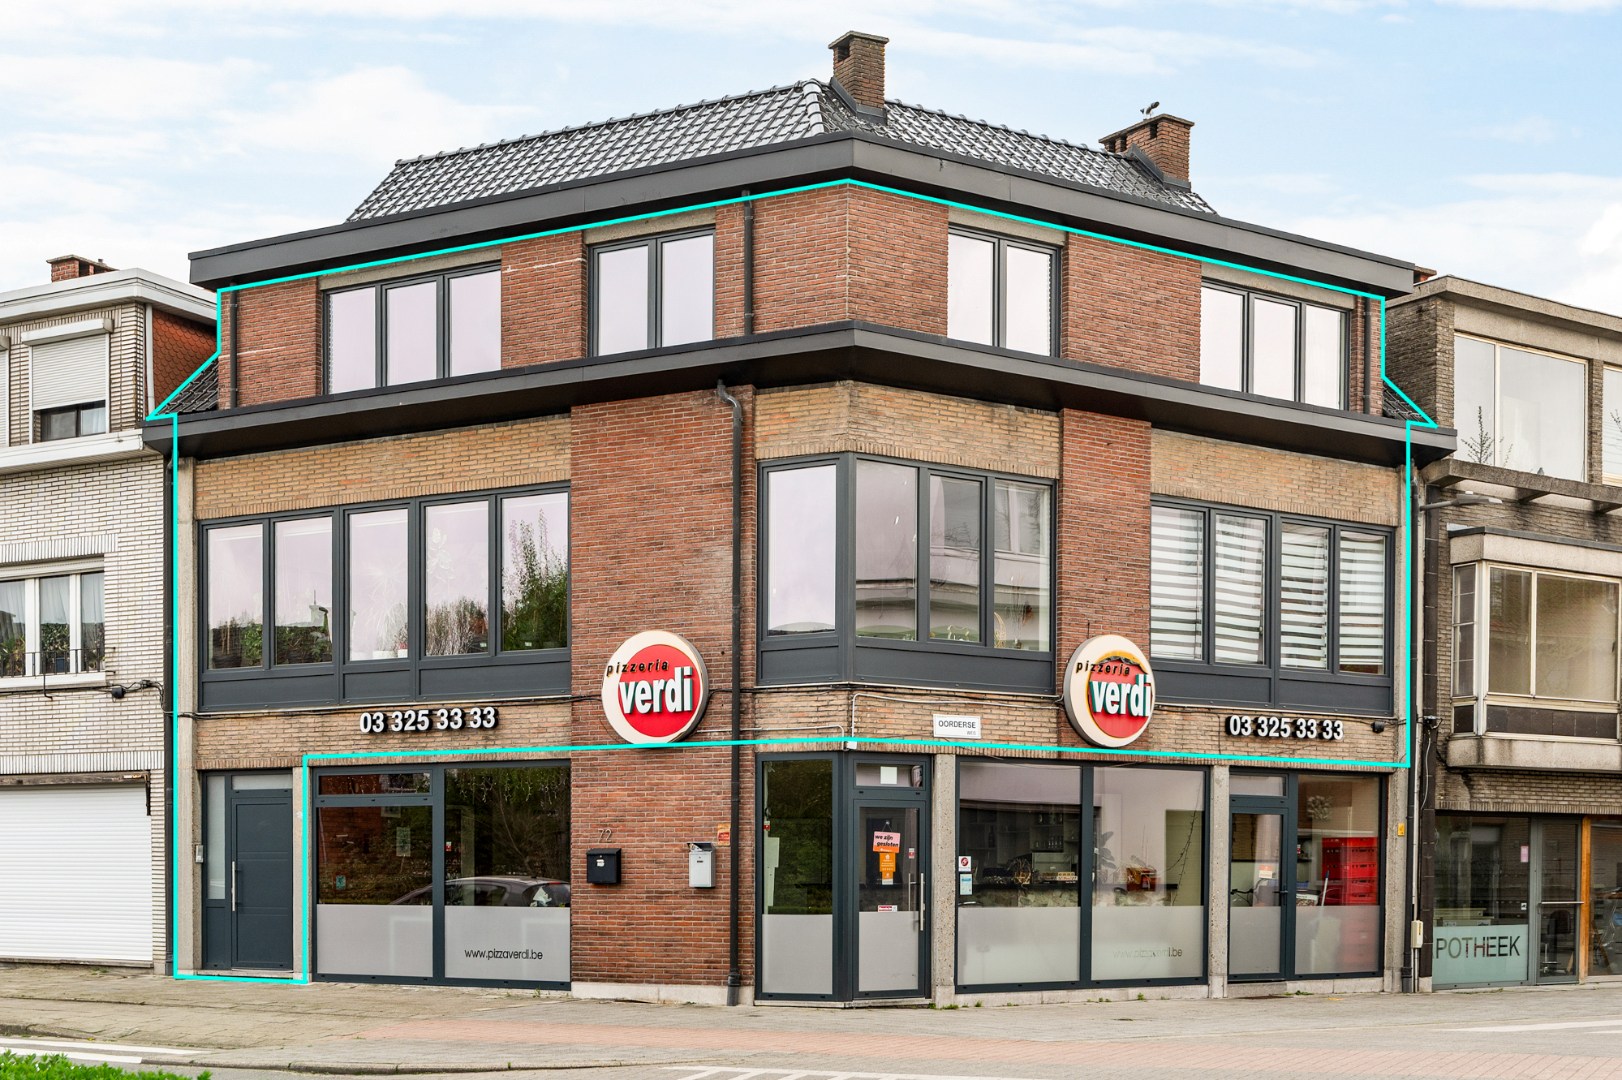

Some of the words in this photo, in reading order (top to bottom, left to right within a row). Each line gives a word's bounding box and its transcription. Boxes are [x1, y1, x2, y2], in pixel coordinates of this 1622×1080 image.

[606, 659, 669, 677] pizzeria
[1076, 661, 1131, 676] pizzeria
[619, 666, 693, 714] verdi
[1089, 674, 1152, 717] verdi
[360, 712, 386, 733] 03
[391, 709, 431, 732] 325
[436, 707, 464, 730] 33
[469, 706, 498, 729] 33
[938, 720, 976, 729] OORDERSE
[1228, 715, 1252, 736] 03
[1256, 716, 1291, 738] 325
[1294, 718, 1318, 739] 33
[1321, 719, 1344, 740] 33
[598, 828, 612, 843] 72
[464, 948, 543, 960] www.pizzaverdi.be
[1432, 935, 1520, 959] POTHEEK
